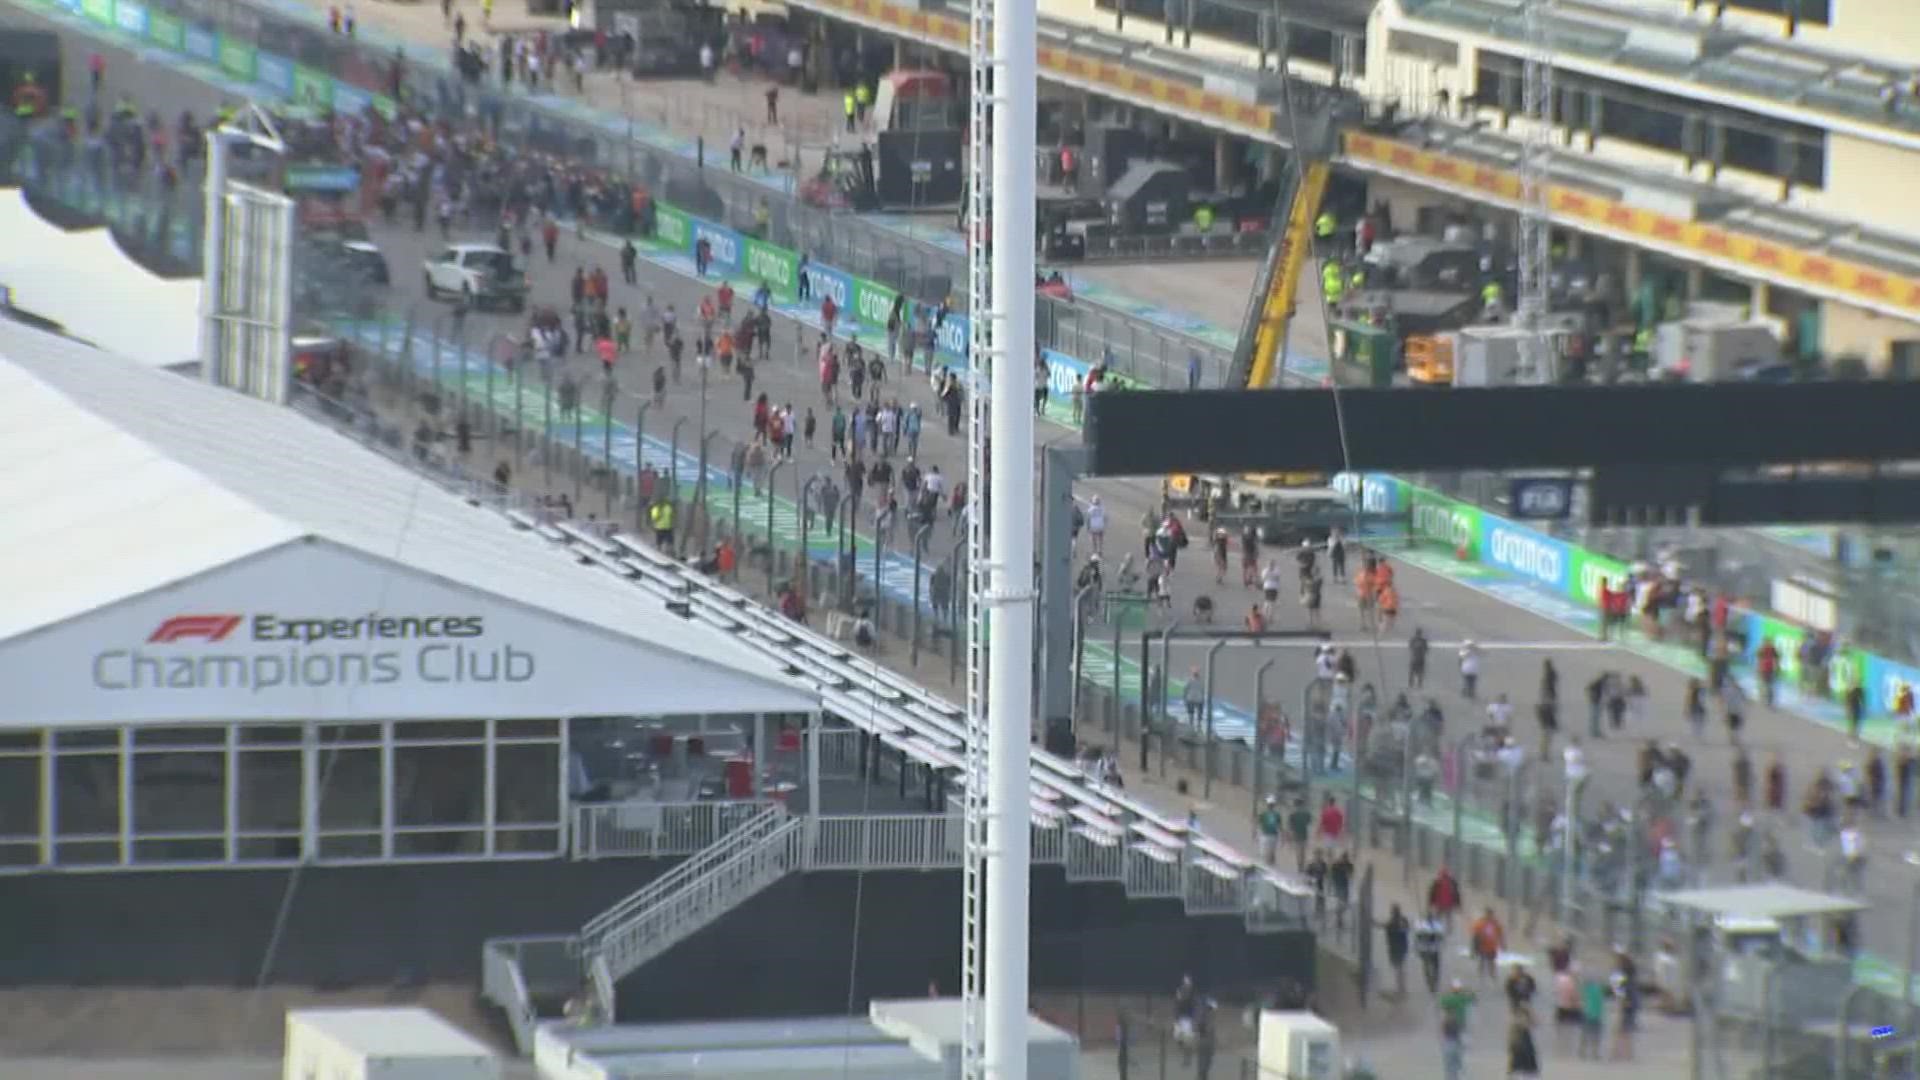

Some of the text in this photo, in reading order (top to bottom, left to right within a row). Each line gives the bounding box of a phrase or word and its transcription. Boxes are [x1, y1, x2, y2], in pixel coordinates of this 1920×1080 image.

[1491, 528, 1559, 582] aramco
[253, 611, 484, 646] Experiences
[92, 643, 536, 694] Champions Club
